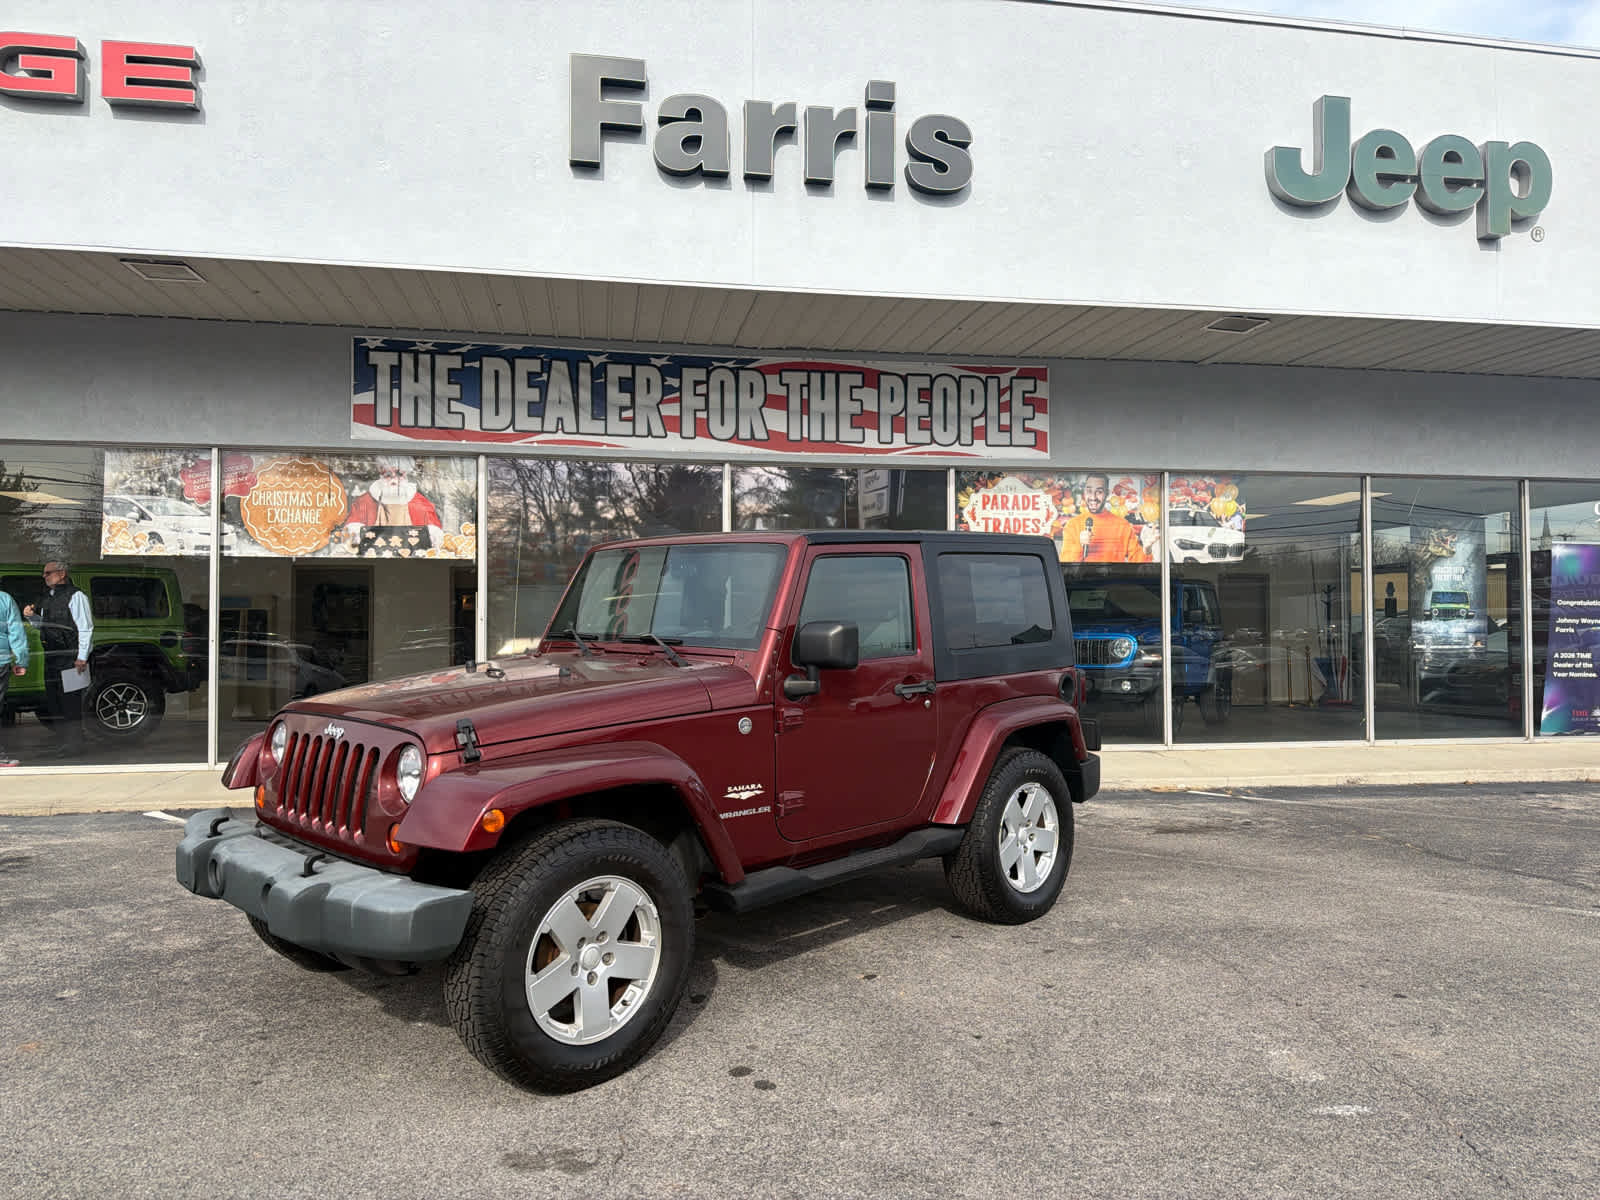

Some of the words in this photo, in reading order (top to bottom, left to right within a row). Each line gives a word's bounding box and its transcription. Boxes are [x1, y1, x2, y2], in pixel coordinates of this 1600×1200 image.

[569, 53, 974, 195] Farris
[1265, 95, 1553, 240] Jeep
[368, 350, 466, 429] THE
[480, 356, 668, 438] DEALER
[680, 365, 770, 442] FOR
[780, 370, 867, 444] THE
[877, 373, 1037, 447] PEOPLE
[251, 490, 314, 507] CHRISTMAS
[315, 492, 338, 508] CAR
[981, 493, 1041, 511] PARADE
[267, 508, 323, 525] EXCHANGE
[981, 517, 1041, 534] TRADES
[1556, 617, 1580, 625] Johnny
[1553, 661, 1574, 669] Dealer
[1582, 661, 1593, 669] the
[727, 784, 762, 792] SAHARA
[720, 806, 771, 819] WRANGLER
